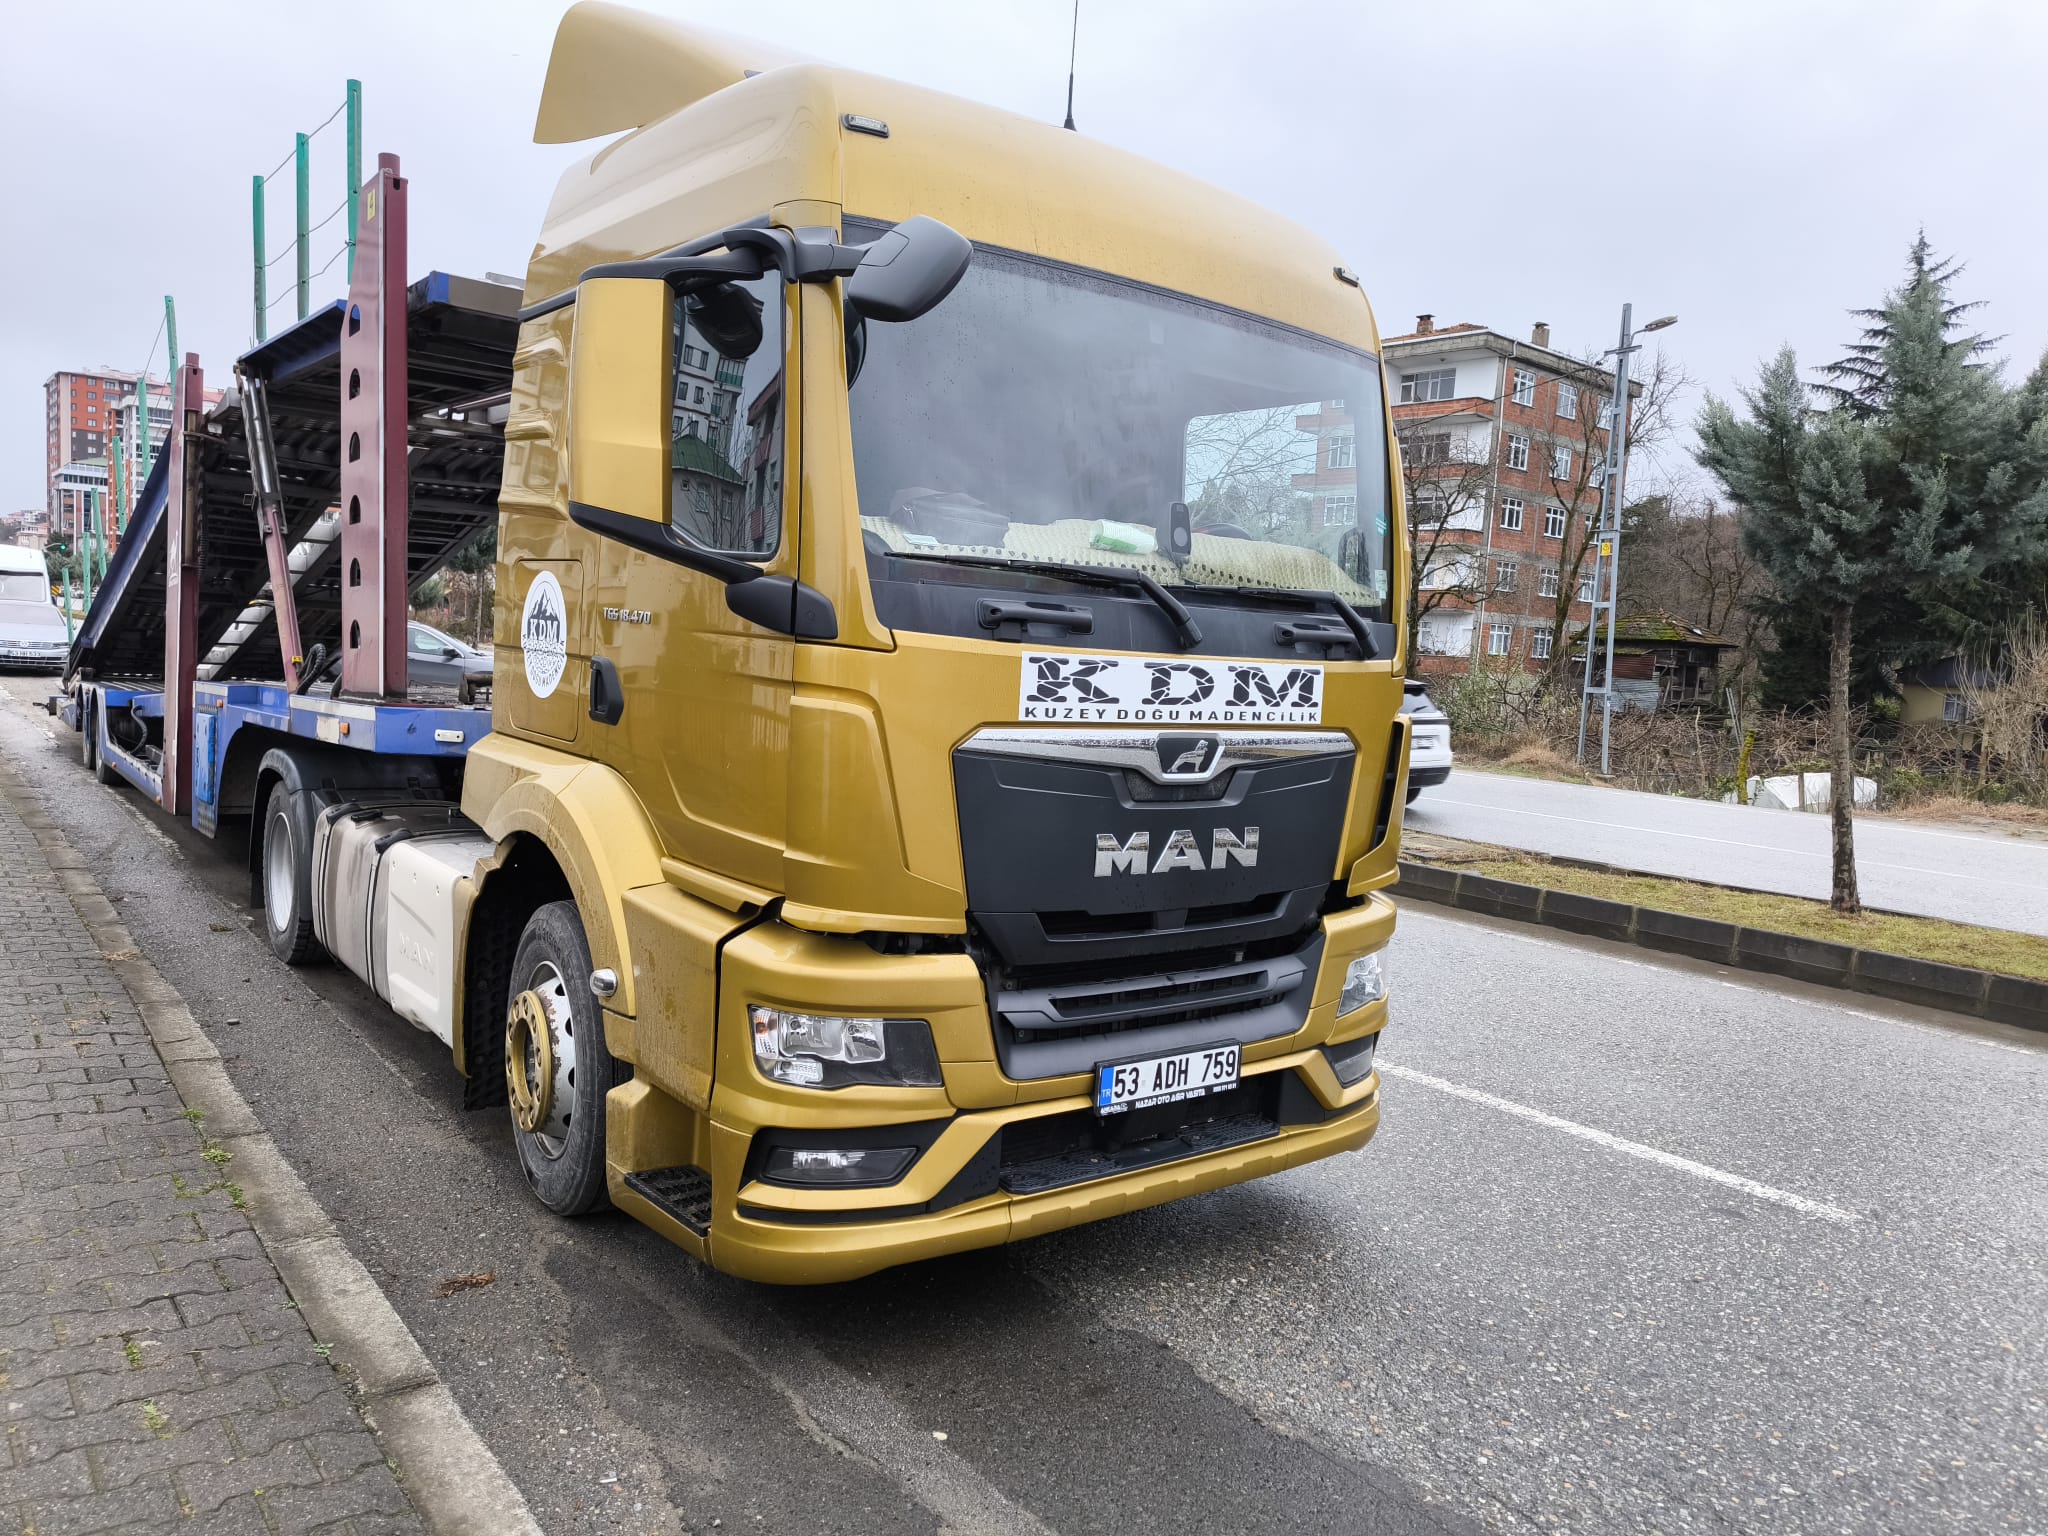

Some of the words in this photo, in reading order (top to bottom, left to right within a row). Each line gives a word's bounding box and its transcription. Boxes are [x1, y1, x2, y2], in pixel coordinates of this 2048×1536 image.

[529, 618, 559, 643] KDM
[1024, 706, 1107, 719] KUZEY
[1116, 708, 1180, 721] DOĞU
[1094, 826, 1260, 877] MAN
[1114, 1067, 1140, 1098] 53
[1152, 1057, 1190, 1092] ADH
[1201, 1050, 1236, 1082] 759
[1101, 1088, 1111, 1098] TR
[1157, 1095, 1171, 1105] OTO
